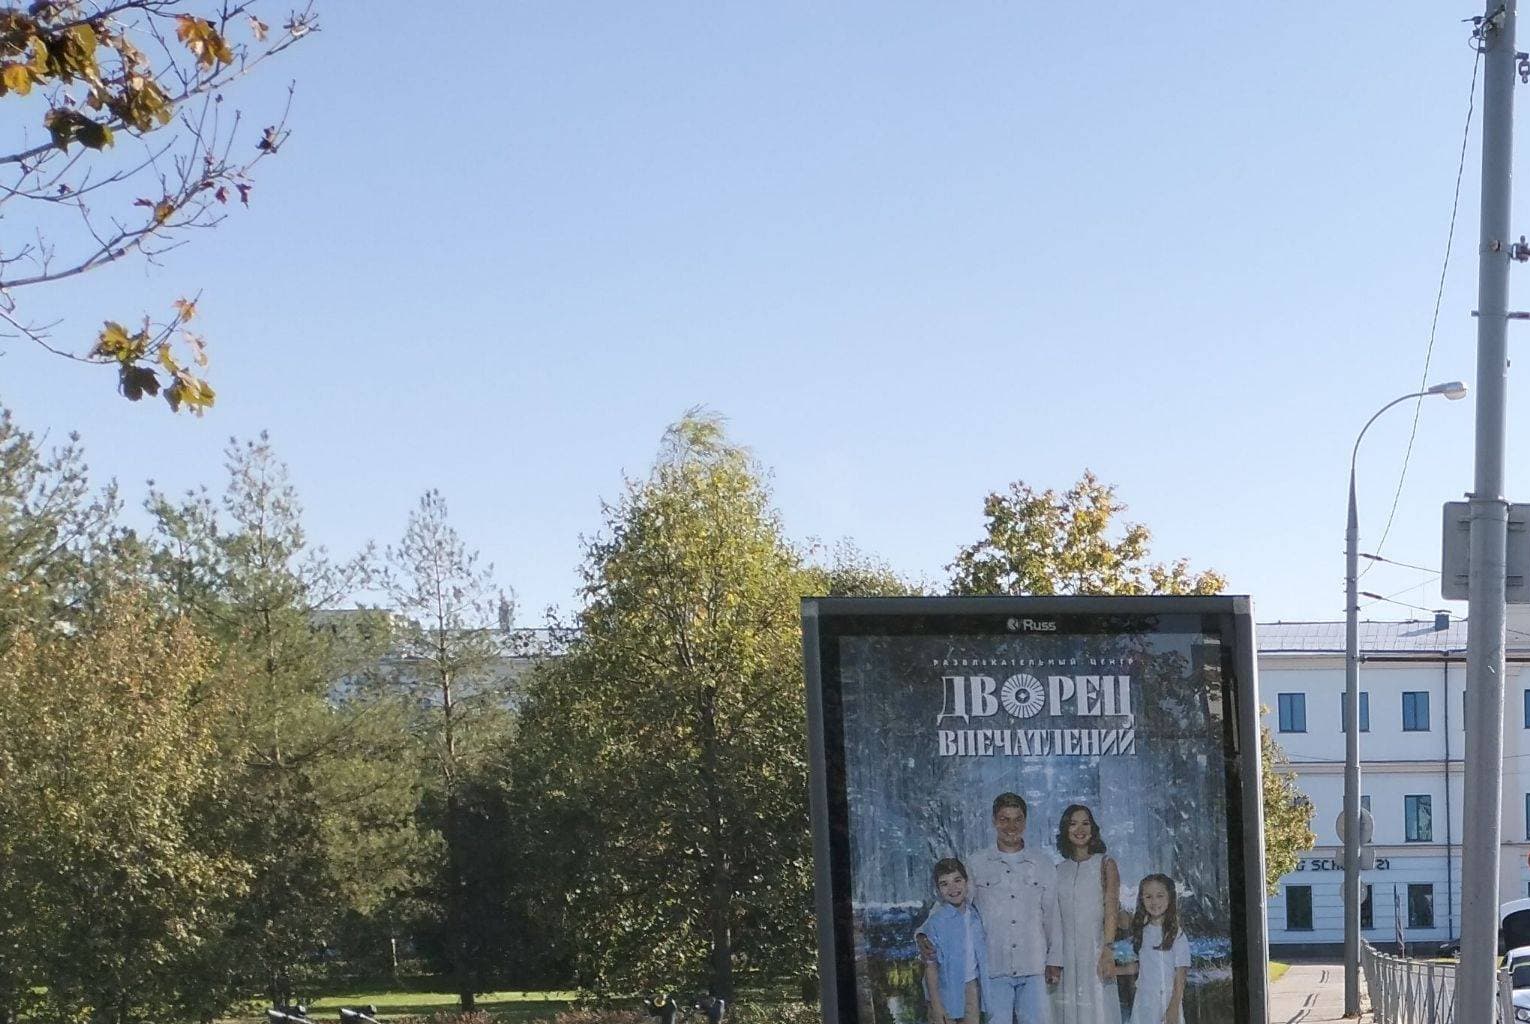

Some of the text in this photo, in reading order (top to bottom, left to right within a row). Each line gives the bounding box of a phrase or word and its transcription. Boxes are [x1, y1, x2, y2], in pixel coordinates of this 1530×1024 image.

[1022, 618, 1057, 631] Russ
[933, 657, 1135, 667] РАЗВЛЕКАТЕЛЬНЫЙ ЦЕНТР
[936, 673, 1136, 729] ДВОРЕЦ
[937, 729, 1136, 756] ВПЕЧАТЛЕНИЙ
